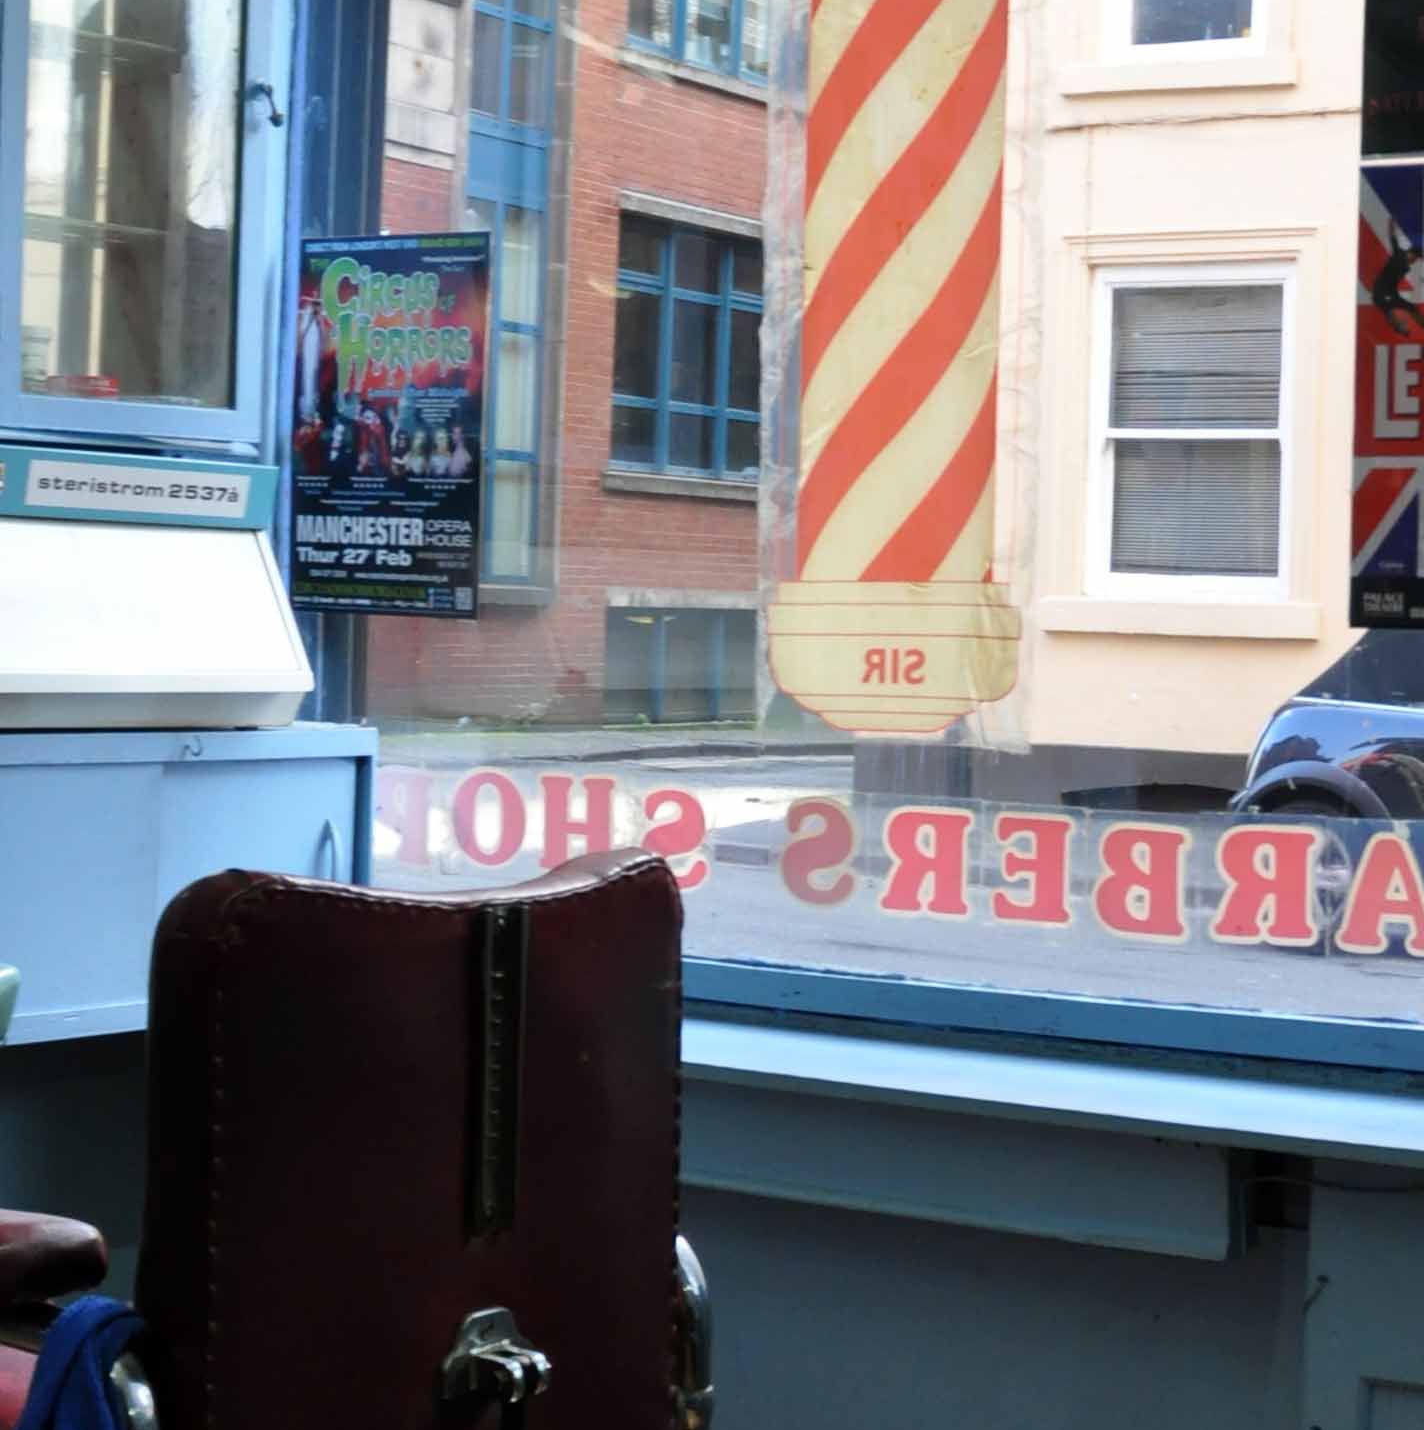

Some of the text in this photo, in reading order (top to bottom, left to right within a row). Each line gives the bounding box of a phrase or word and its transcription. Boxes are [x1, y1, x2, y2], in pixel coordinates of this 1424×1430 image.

[336, 311, 473, 383] HORRORS
[37, 476, 164, 499] steristrom
[296, 514, 424, 547] MANCHESTER
[424, 519, 473, 533] OPERA
[424, 533, 473, 548] HOUSE
[296, 546, 339, 564] Thur
[375, 549, 413, 567] Feb
